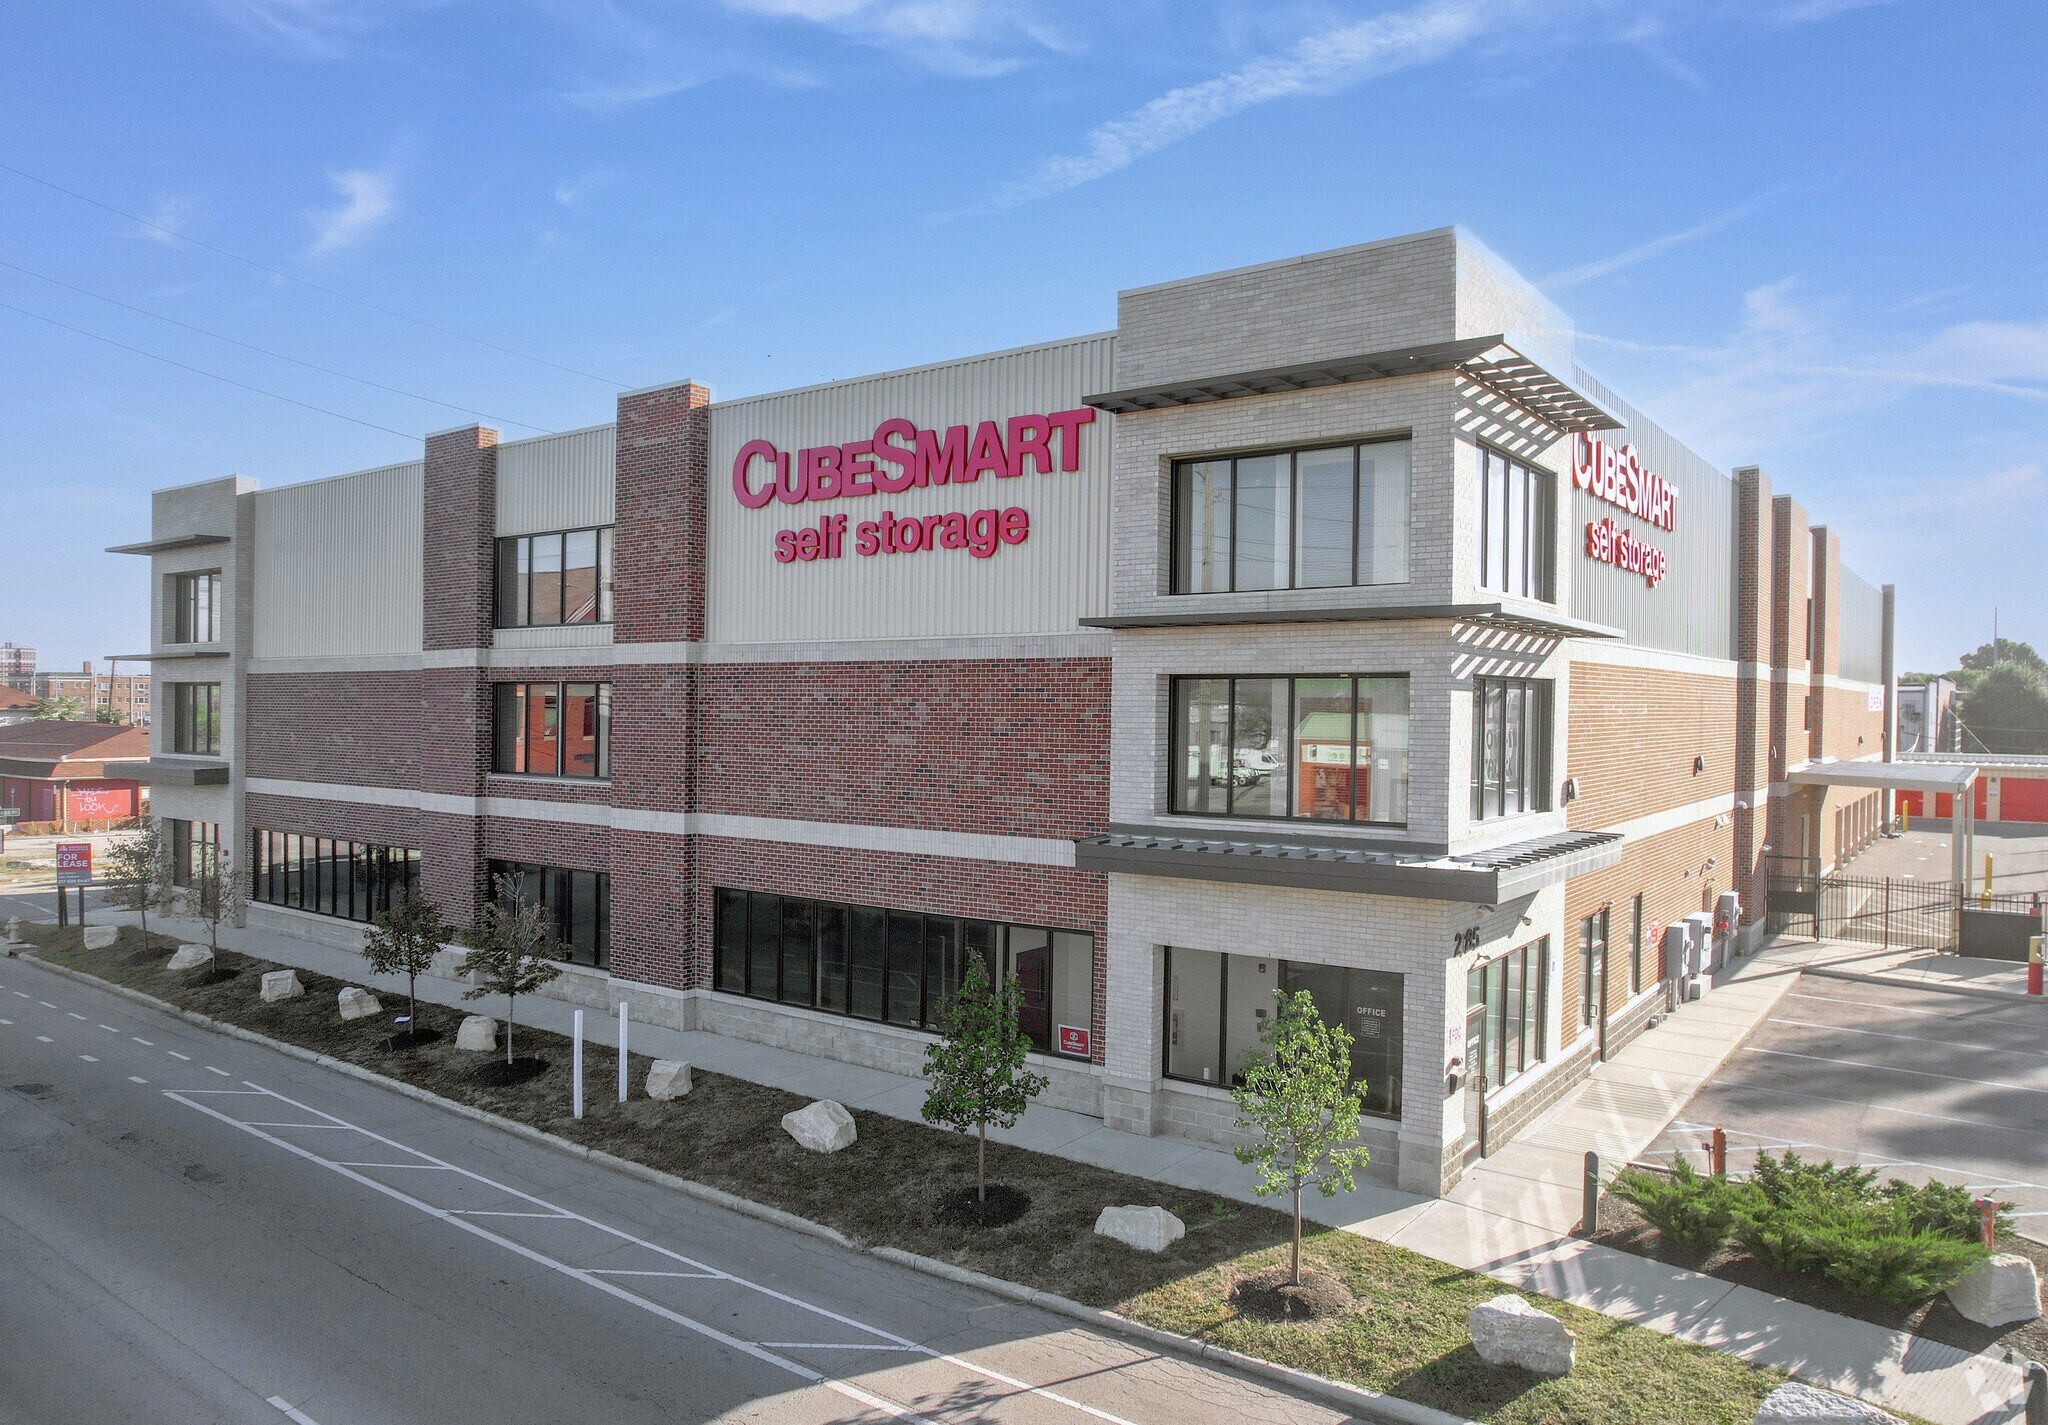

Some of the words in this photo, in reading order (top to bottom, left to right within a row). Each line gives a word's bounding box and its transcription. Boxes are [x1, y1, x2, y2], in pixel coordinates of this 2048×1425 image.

[774, 513, 848, 564] self
[855, 506, 1030, 559] storage
[1585, 517, 1618, 565] self
[1615, 528, 1667, 589] storage
[57, 853, 78, 861] FOR
[57, 860, 89, 868] LEASE
[1356, 1006, 1386, 1018] OFFICE
